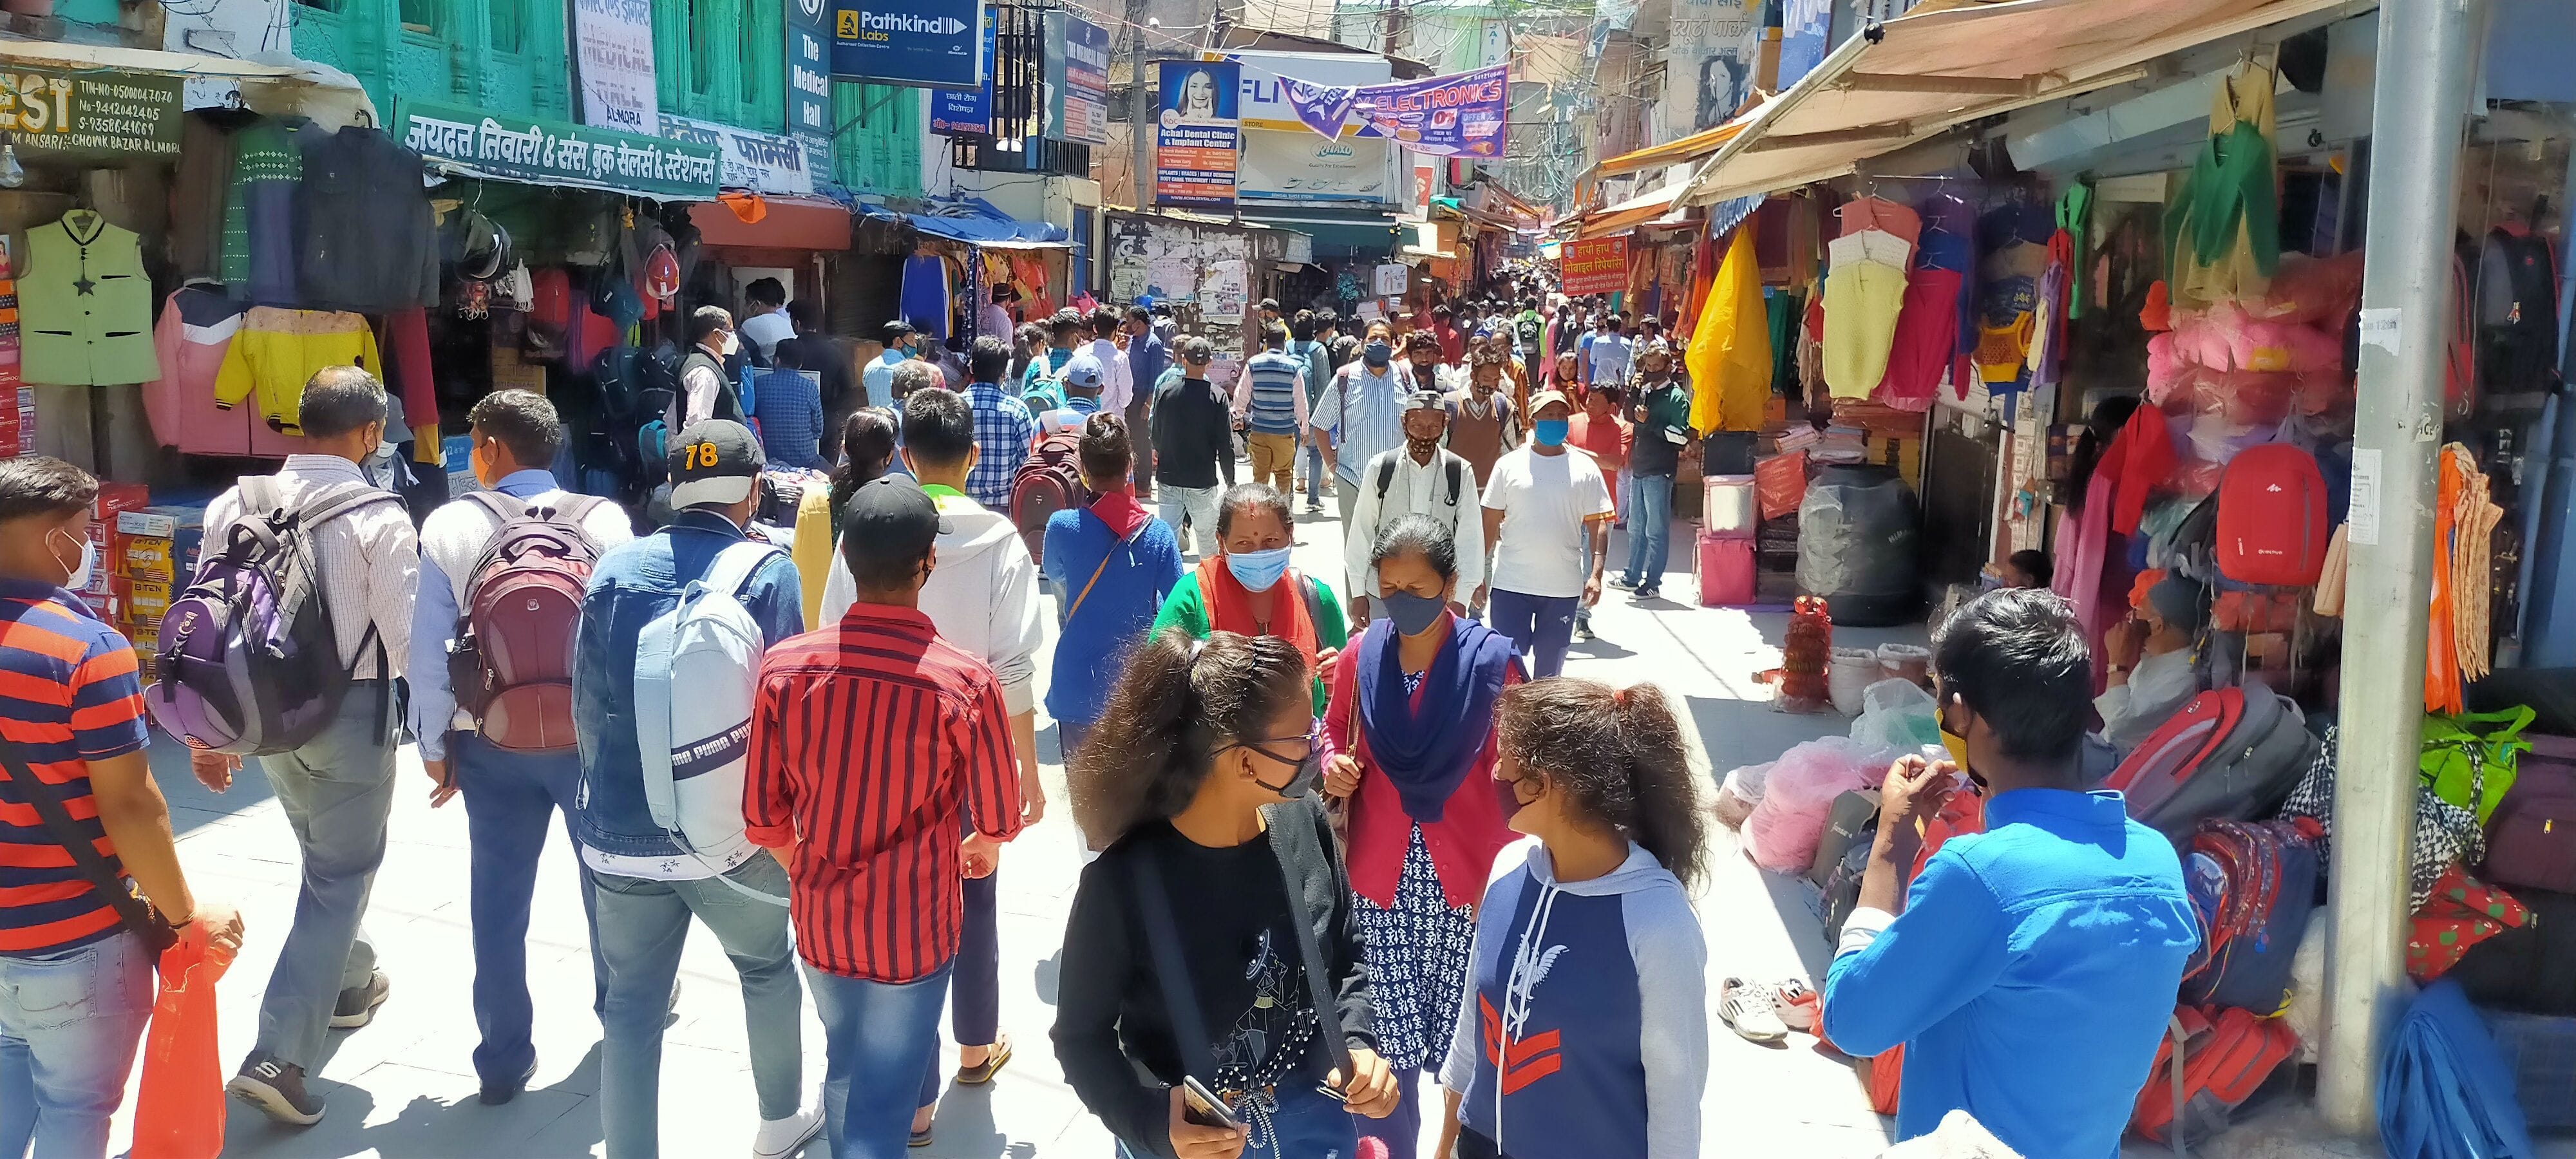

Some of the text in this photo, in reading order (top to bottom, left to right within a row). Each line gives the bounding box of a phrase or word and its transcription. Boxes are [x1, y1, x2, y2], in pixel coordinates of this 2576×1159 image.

[862, 11, 942, 34] Pathkind
[802, 33, 819, 61] The
[862, 29, 889, 42] Labs
[1066, 40, 1076, 59] THE
[1076, 43, 1097, 66] MEDICAL
[793, 64, 828, 97] Medical
[1242, 79, 1280, 104] FLI
[1374, 79, 1502, 112] ELECTRONICS
[607, 104, 641, 126] ALMORA
[803, 101, 820, 127] Hall
[110, 134, 142, 152] BAZAR
[144, 140, 182, 154] ALMORA
[1160, 129, 1235, 140] Achal Dental Clinic
[1164, 138, 1231, 148] & Implant Center
[478, 117, 544, 165] तिवारी
[542, 134, 555, 169] &
[592, 143, 615, 180] बुक
[616, 139, 654, 178] सेलर्स
[654, 149, 663, 180] &
[664, 147, 715, 185] स्टेशनर्स
[1564, 260, 1593, 274] मोबाइल
[685, 442, 719, 470] 78
[693, 736, 731, 759] PUMA
